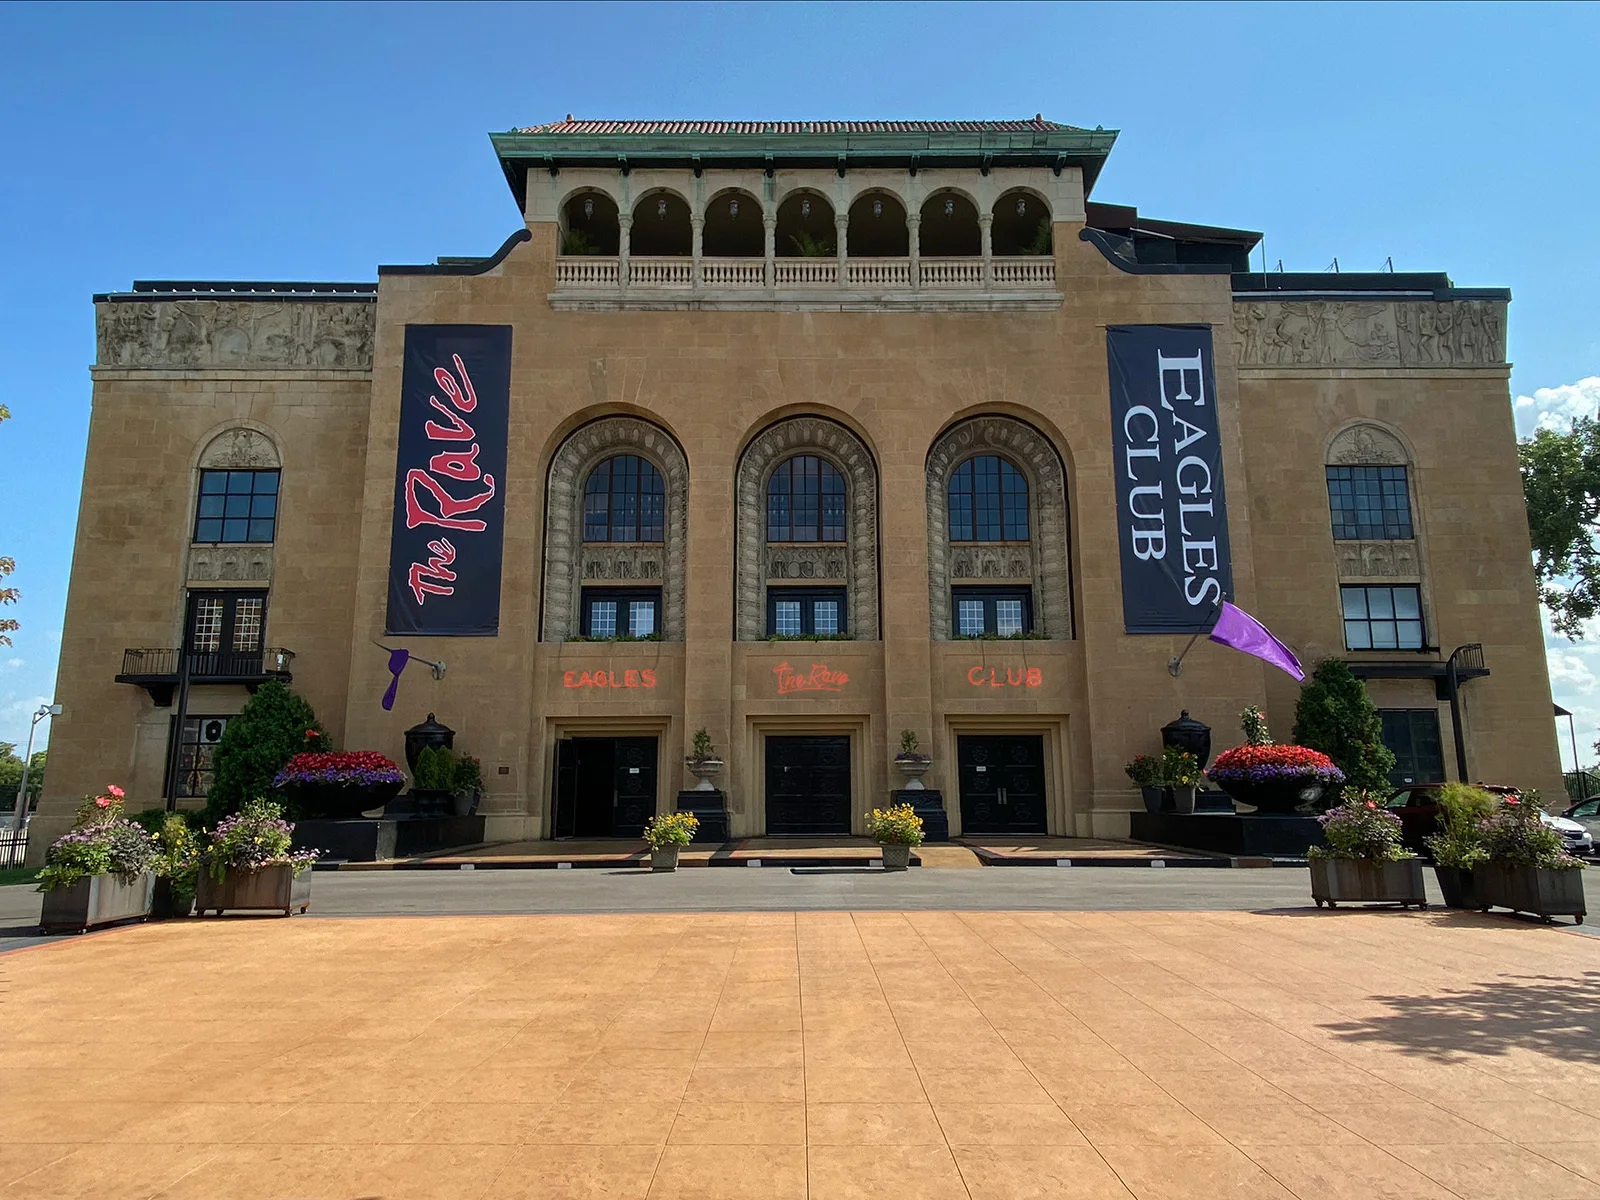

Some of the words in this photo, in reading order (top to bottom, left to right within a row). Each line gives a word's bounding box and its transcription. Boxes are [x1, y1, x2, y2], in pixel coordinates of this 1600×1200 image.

[405, 353, 496, 532] Rave
[1123, 405, 1168, 561] CLUB
[1157, 348, 1221, 607] EAGLES
[408, 537, 457, 605] The
[563, 669, 657, 688] EAGLES
[773, 662, 806, 691] The
[807, 664, 849, 689] Rave
[967, 666, 1042, 687] CLUB
